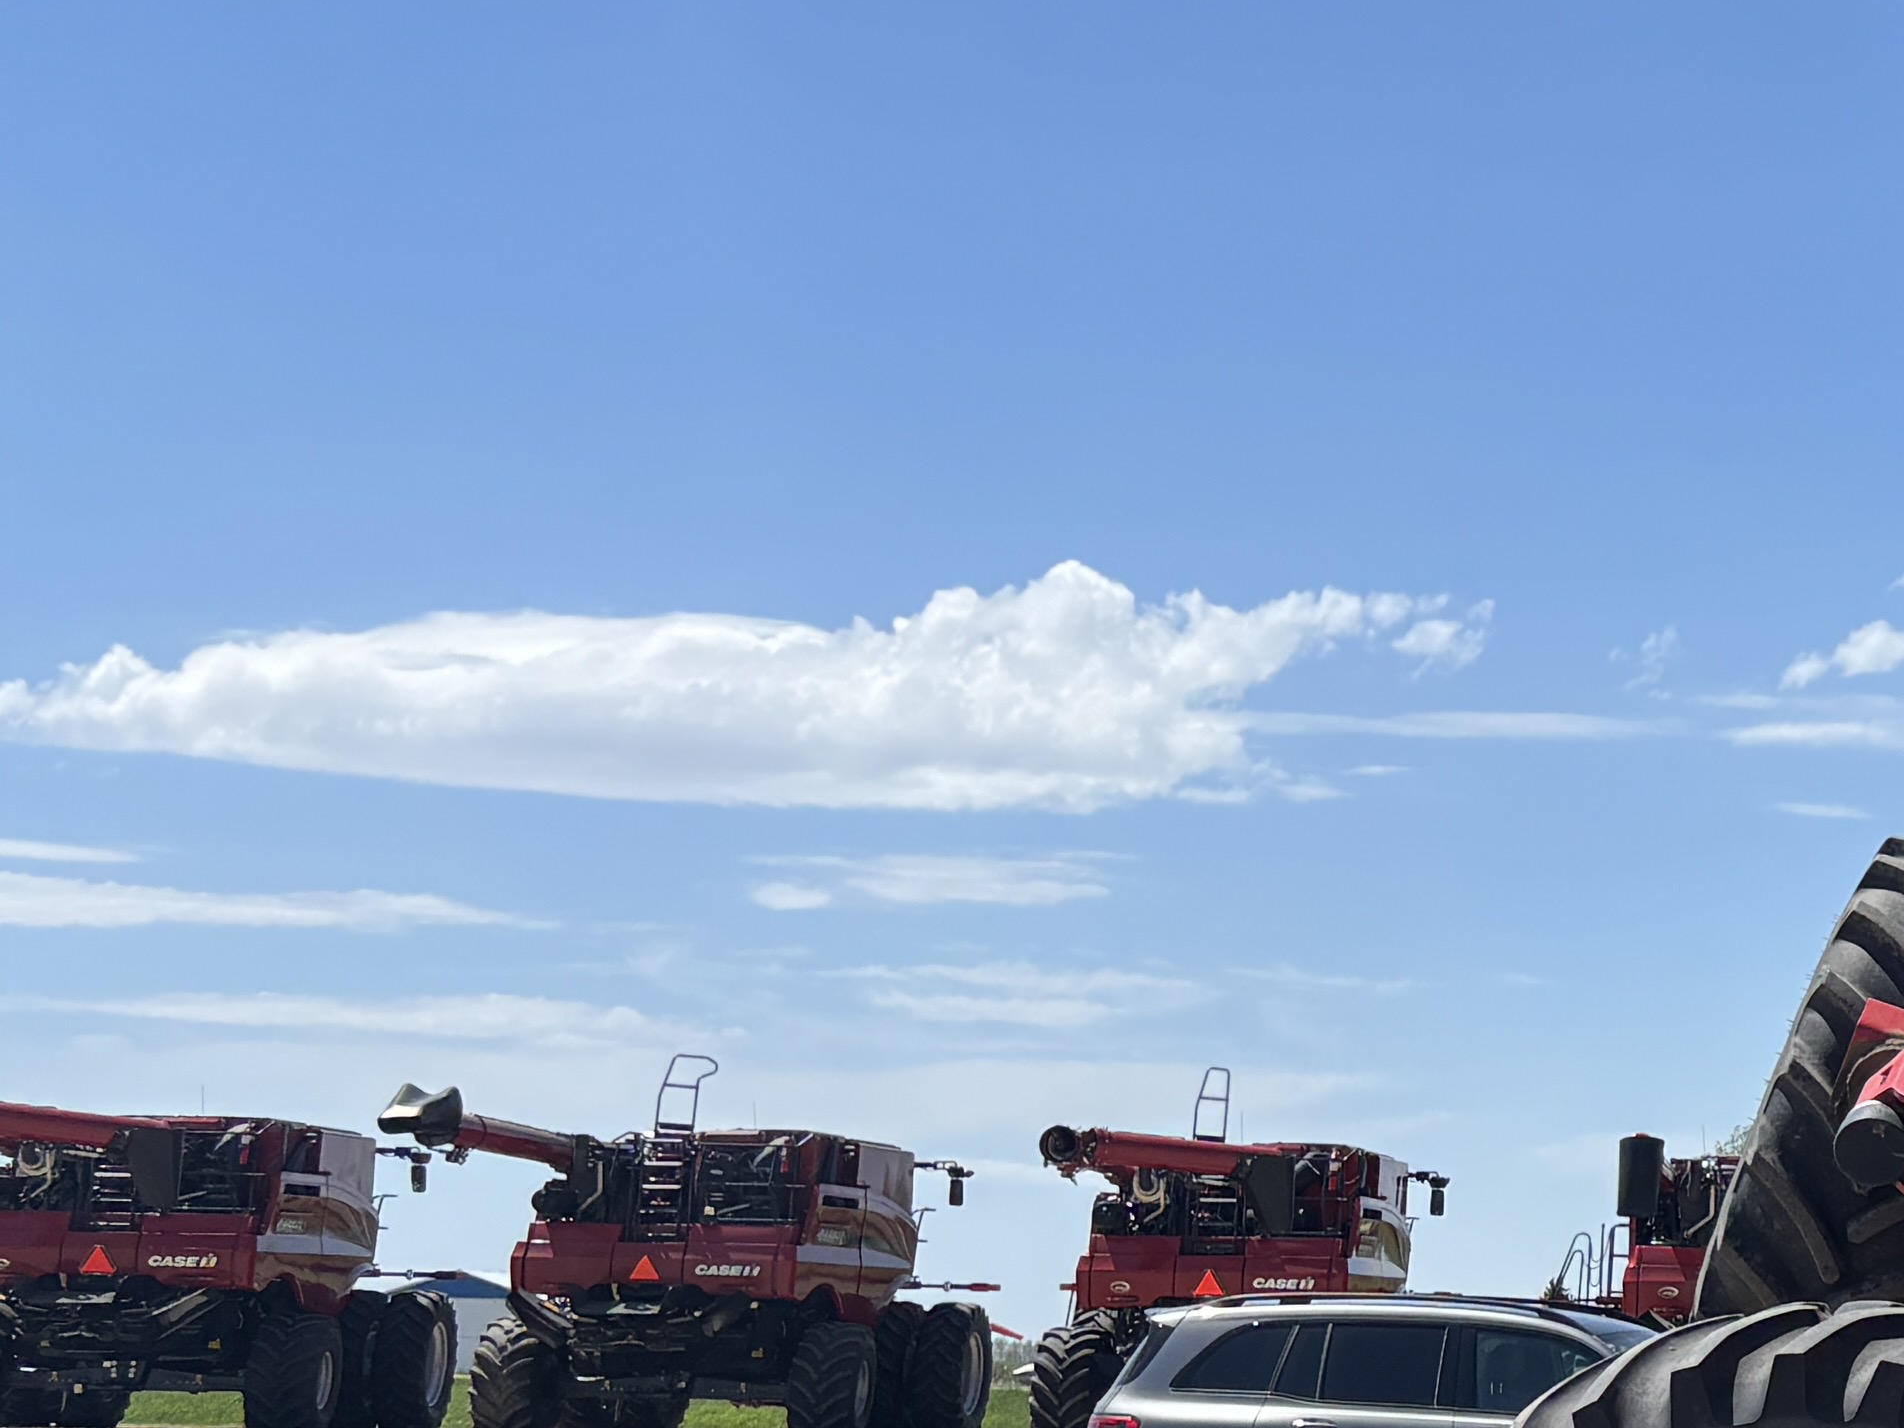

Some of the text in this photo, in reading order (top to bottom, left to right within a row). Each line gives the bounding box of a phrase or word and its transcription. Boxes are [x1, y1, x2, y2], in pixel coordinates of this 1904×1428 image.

[148, 1255, 199, 1268] CASE
[694, 1264, 742, 1277] CASE
[1252, 1277, 1297, 1290] CASE
